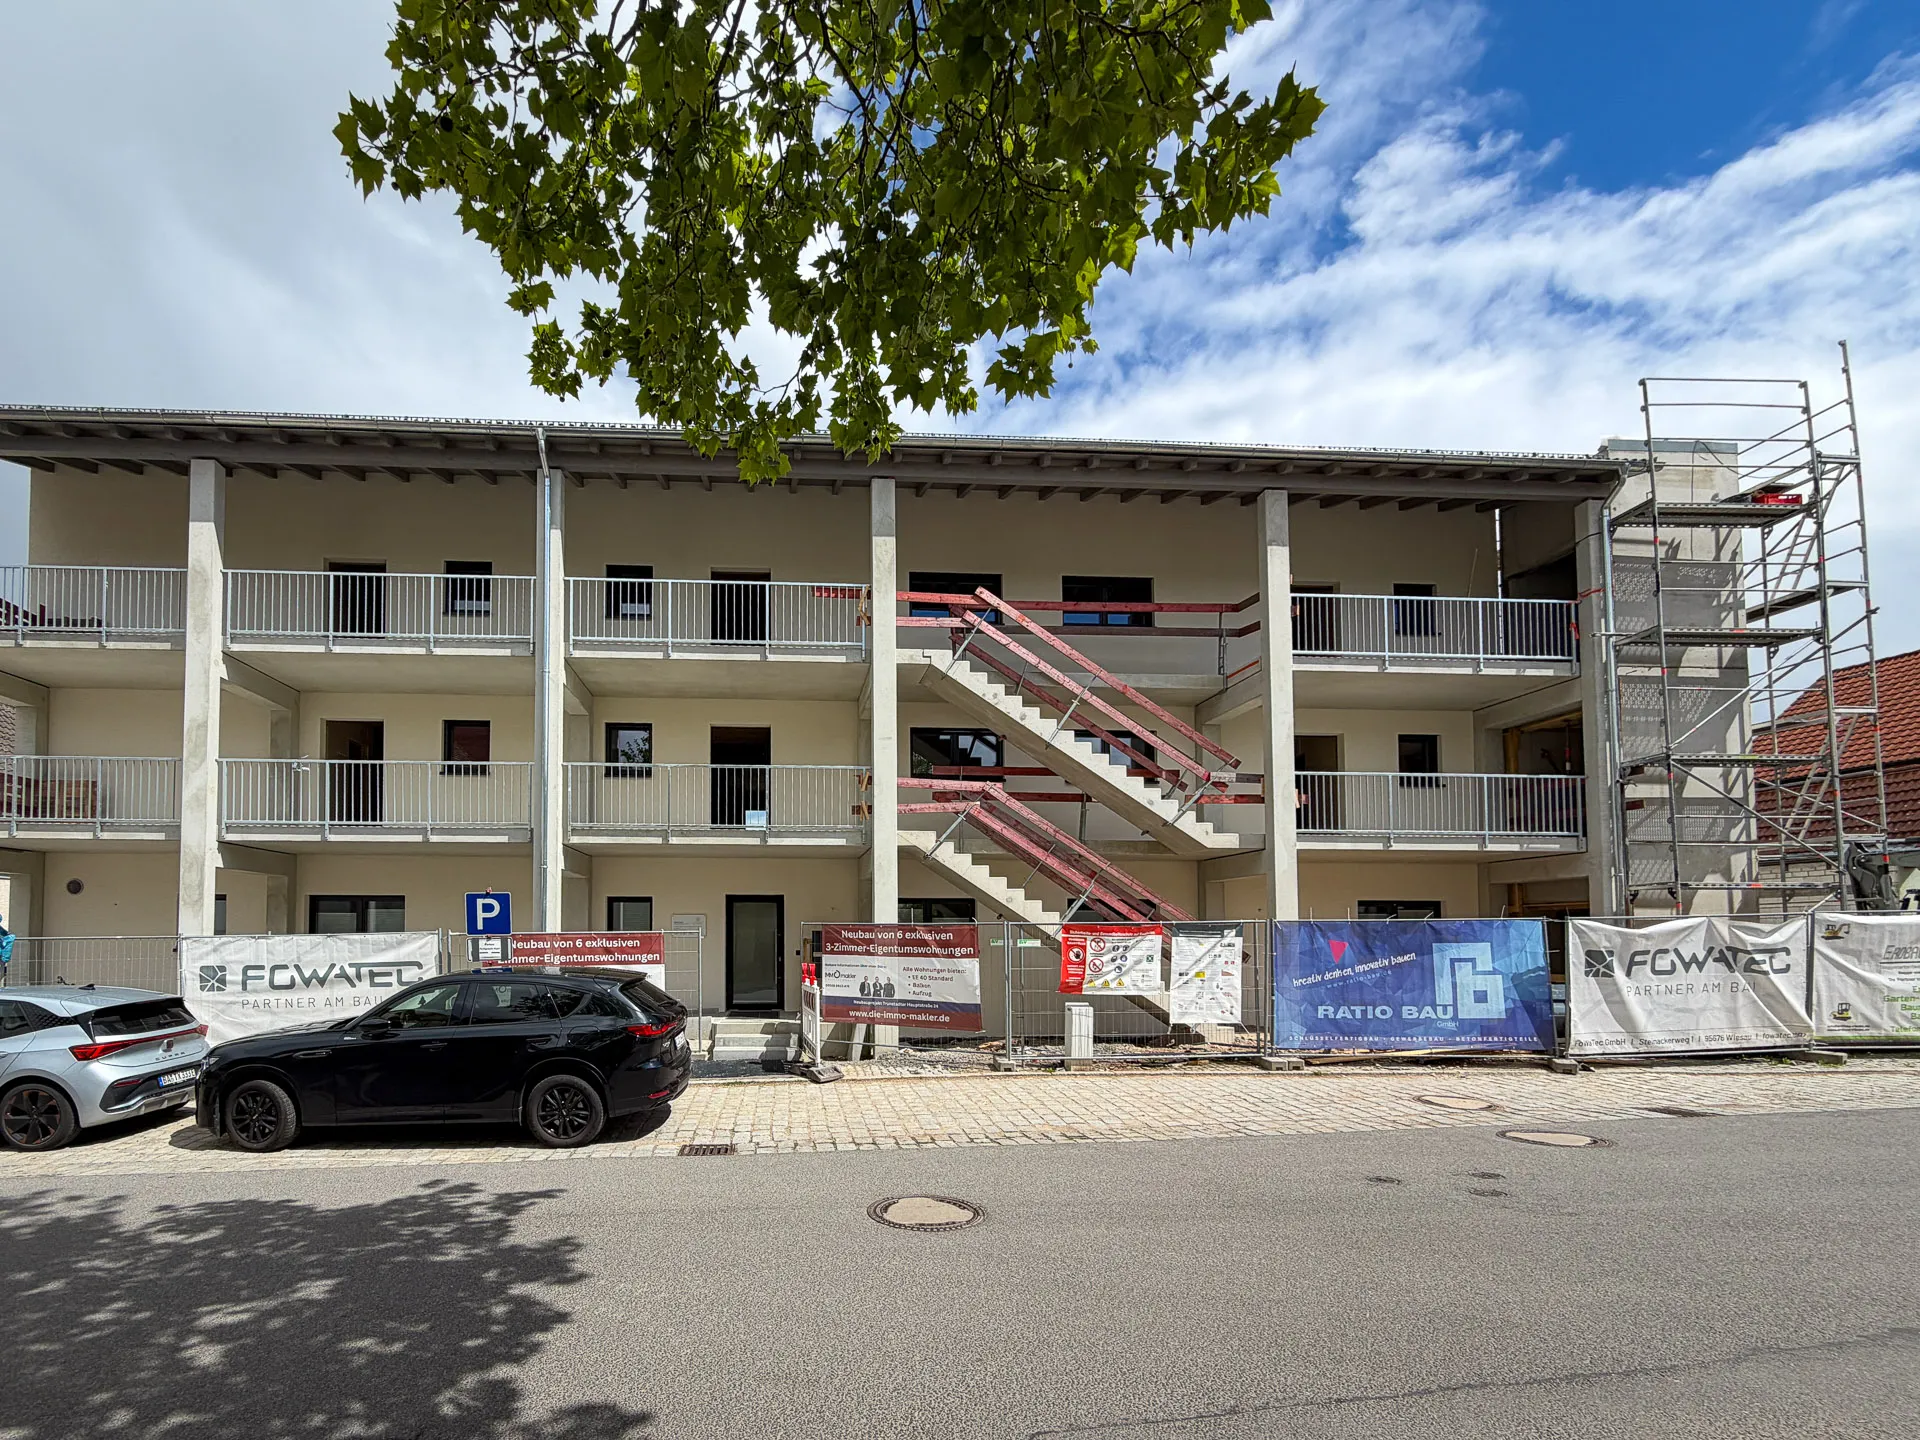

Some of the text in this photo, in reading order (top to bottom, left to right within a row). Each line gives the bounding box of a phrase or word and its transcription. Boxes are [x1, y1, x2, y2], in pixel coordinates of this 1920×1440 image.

[476, 898, 501, 930] P
[841, 930, 953, 940] Neubau von 6 exklusiven
[511, 938, 640, 949] Neubau von 6 exklusiven
[825, 943, 974, 957] 3-Zimmer-Eigentumswohnungen
[498, 952, 660, 964] mmer-Eigentumswohnungen
[1883, 945, 1920, 960] ERDBA
[1292, 952, 1417, 988] kreativ denken, innovativ bauen
[1626, 982, 1694, 997] PARTNER
[1701, 981, 1721, 993] AM
[241, 995, 383, 1009] PARTNER AM BAU
[849, 1010, 950, 1023] www.die-immo-makler.de
[1317, 1005, 1454, 1019] RATIO BAU
[1437, 1020, 1459, 1028] GmbH
[1605, 1038, 1626, 1046] GmbH
